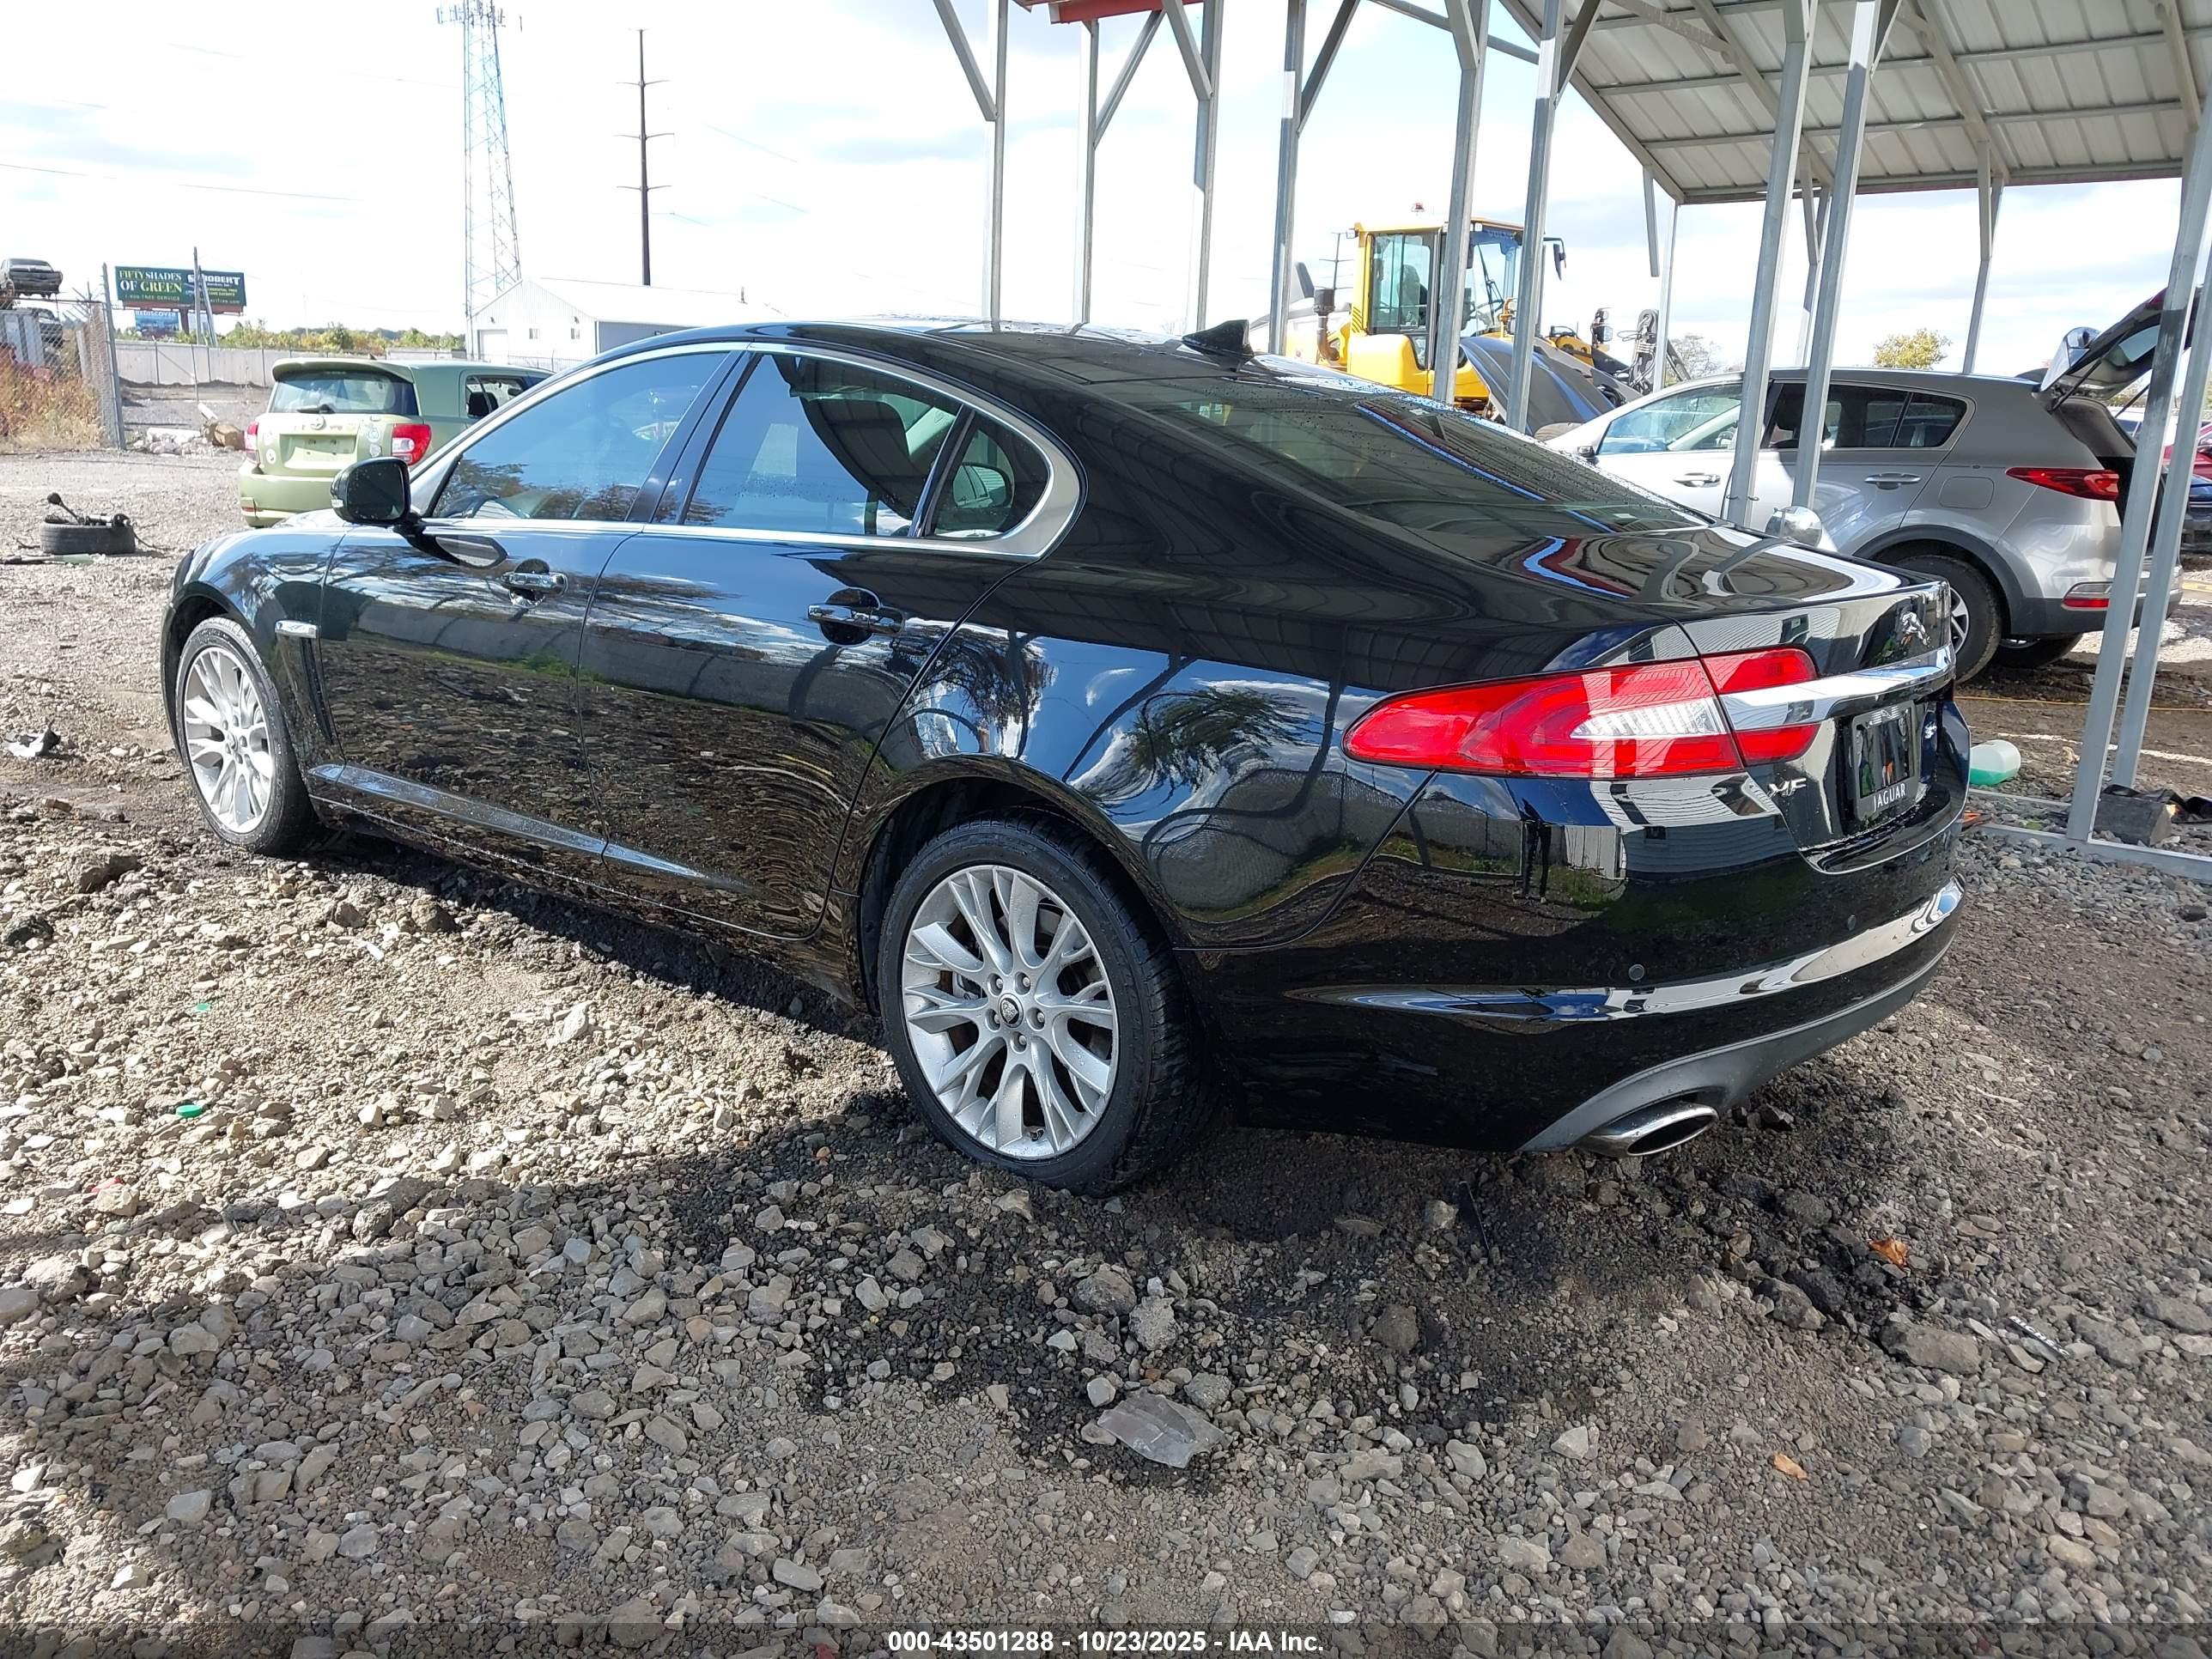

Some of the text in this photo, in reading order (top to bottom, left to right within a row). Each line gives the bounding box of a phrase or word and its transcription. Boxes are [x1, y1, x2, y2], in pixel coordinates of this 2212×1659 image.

[119, 270, 182, 281] FIFTY SHADES
[120, 280, 137, 291] OF
[140, 281, 182, 293] GREEN
[1873, 782, 1906, 812] JAGUAR
